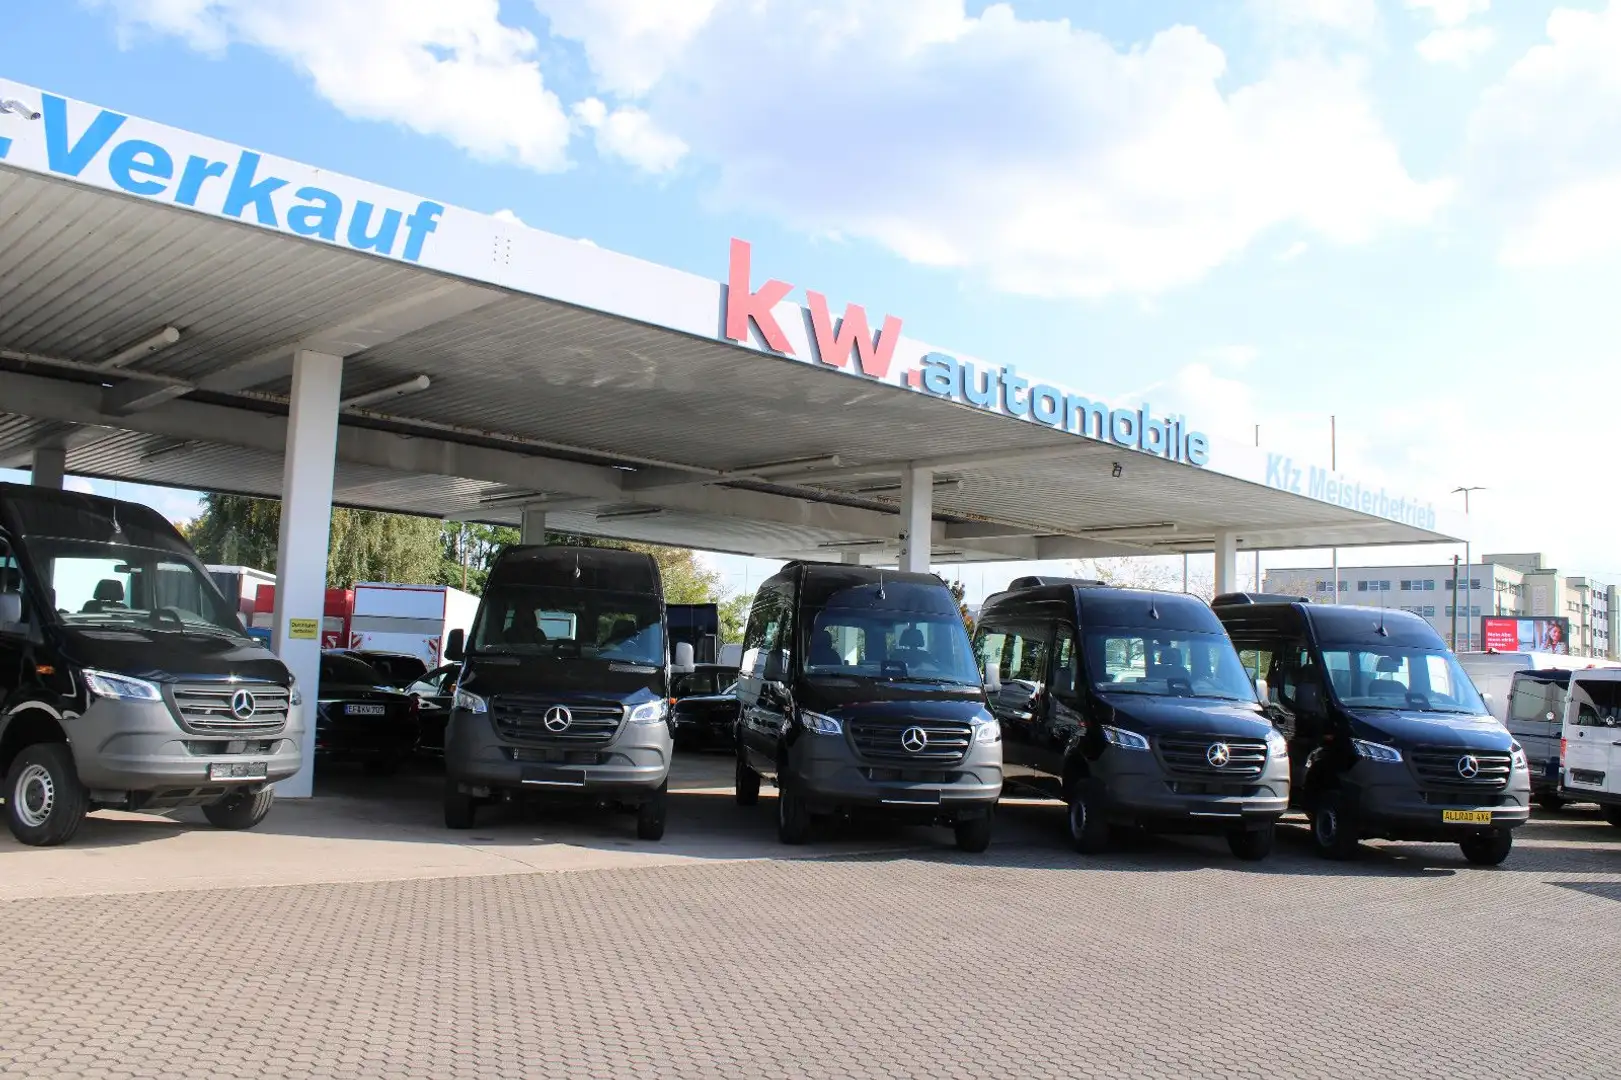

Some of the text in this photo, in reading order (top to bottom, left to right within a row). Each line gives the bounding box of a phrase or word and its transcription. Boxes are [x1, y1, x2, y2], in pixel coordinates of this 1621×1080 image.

[41, 93, 443, 261] Verkauf
[1266, 452, 1436, 530] Kfz Meisterbetrieb
[1444, 810, 1474, 821] ALLRAD
